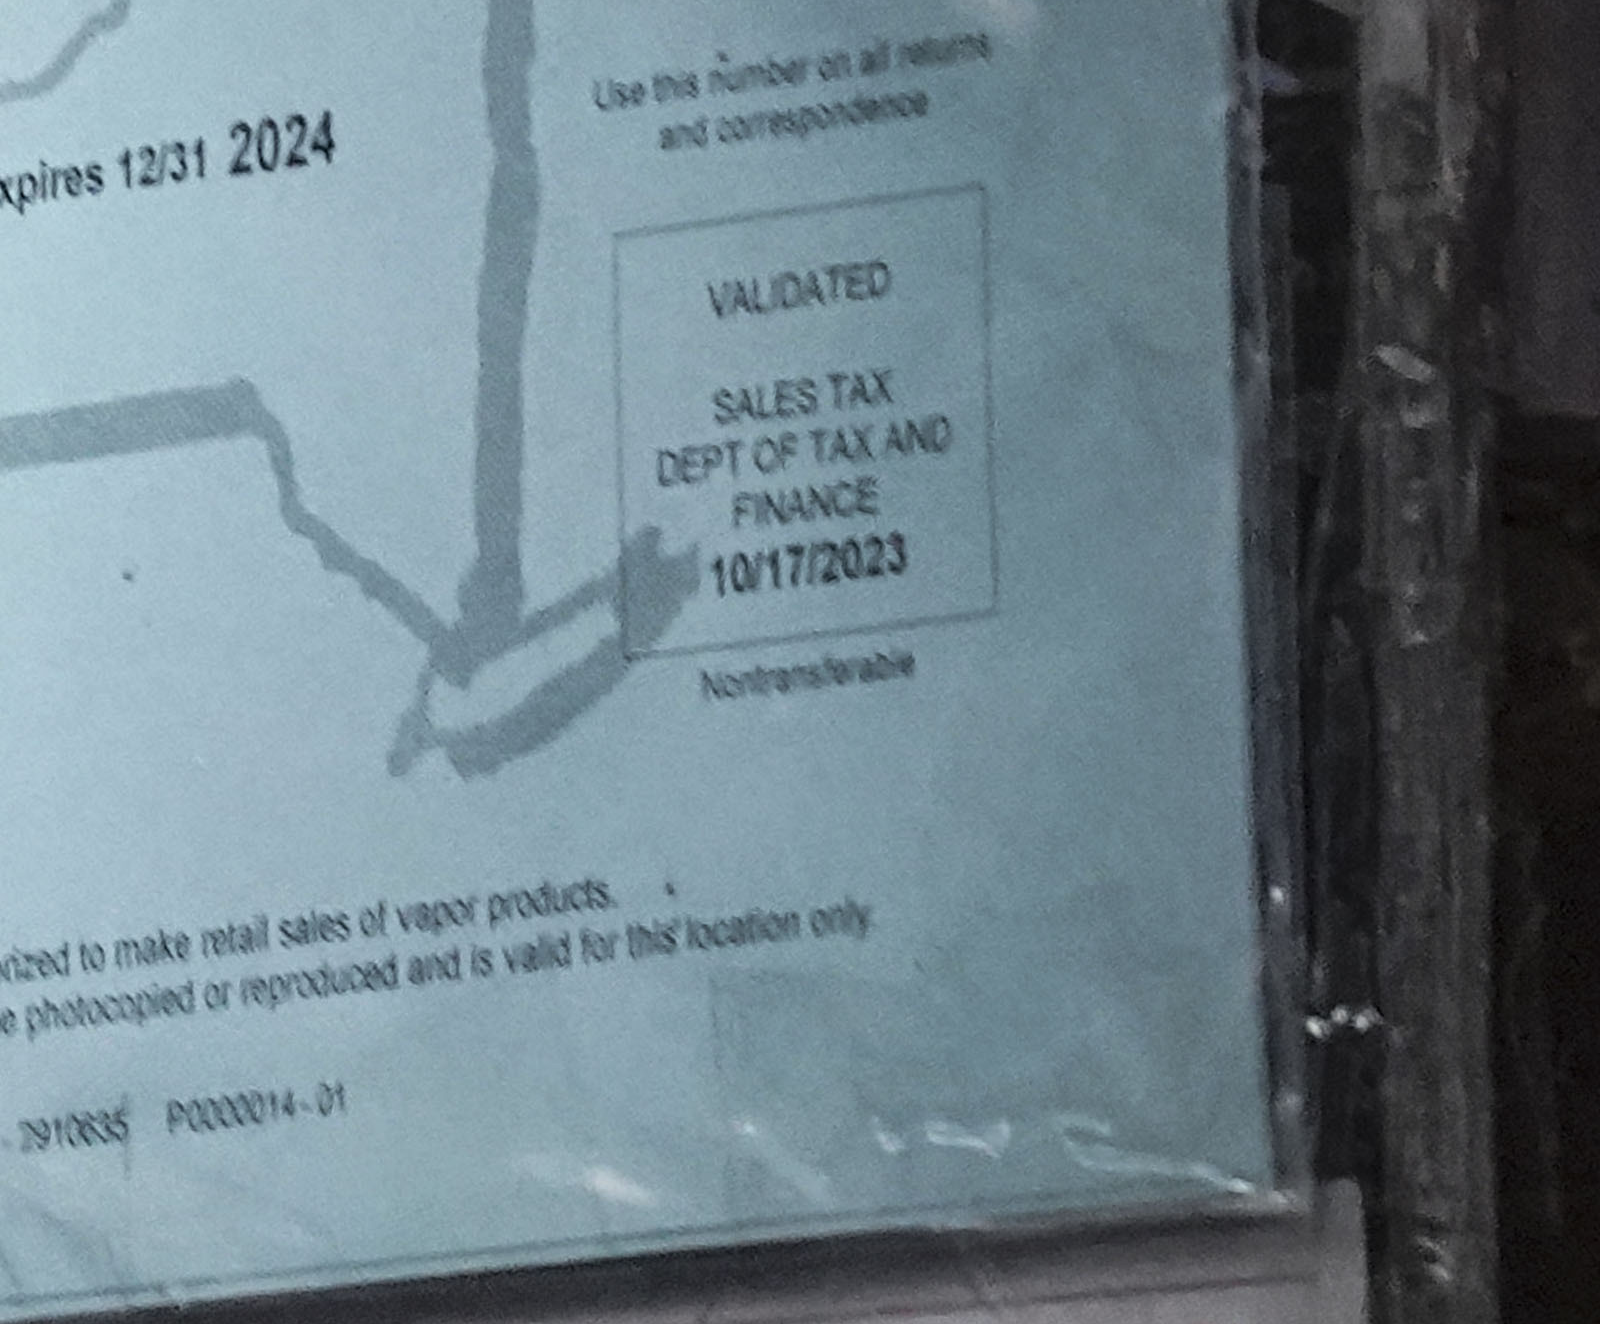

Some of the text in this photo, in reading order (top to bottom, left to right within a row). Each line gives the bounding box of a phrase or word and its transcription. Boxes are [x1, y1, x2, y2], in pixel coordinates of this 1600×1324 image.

[118, 137, 207, 190] 12/31
[227, 110, 337, 177] 2024
[707, 259, 892, 318] VALIDATED
[712, 369, 894, 425] SALES TAX
[656, 415, 952, 488] DEPT OF TAX AND
[732, 477, 880, 529] FINANCE
[710, 531, 909, 597] 10/17/2023
[79, 939, 107, 971] to
[115, 929, 191, 966] make
[201, 917, 268, 956] retail
[279, 911, 350, 946] sales
[360, 903, 387, 936] of
[397, 899, 478, 933] vapor
